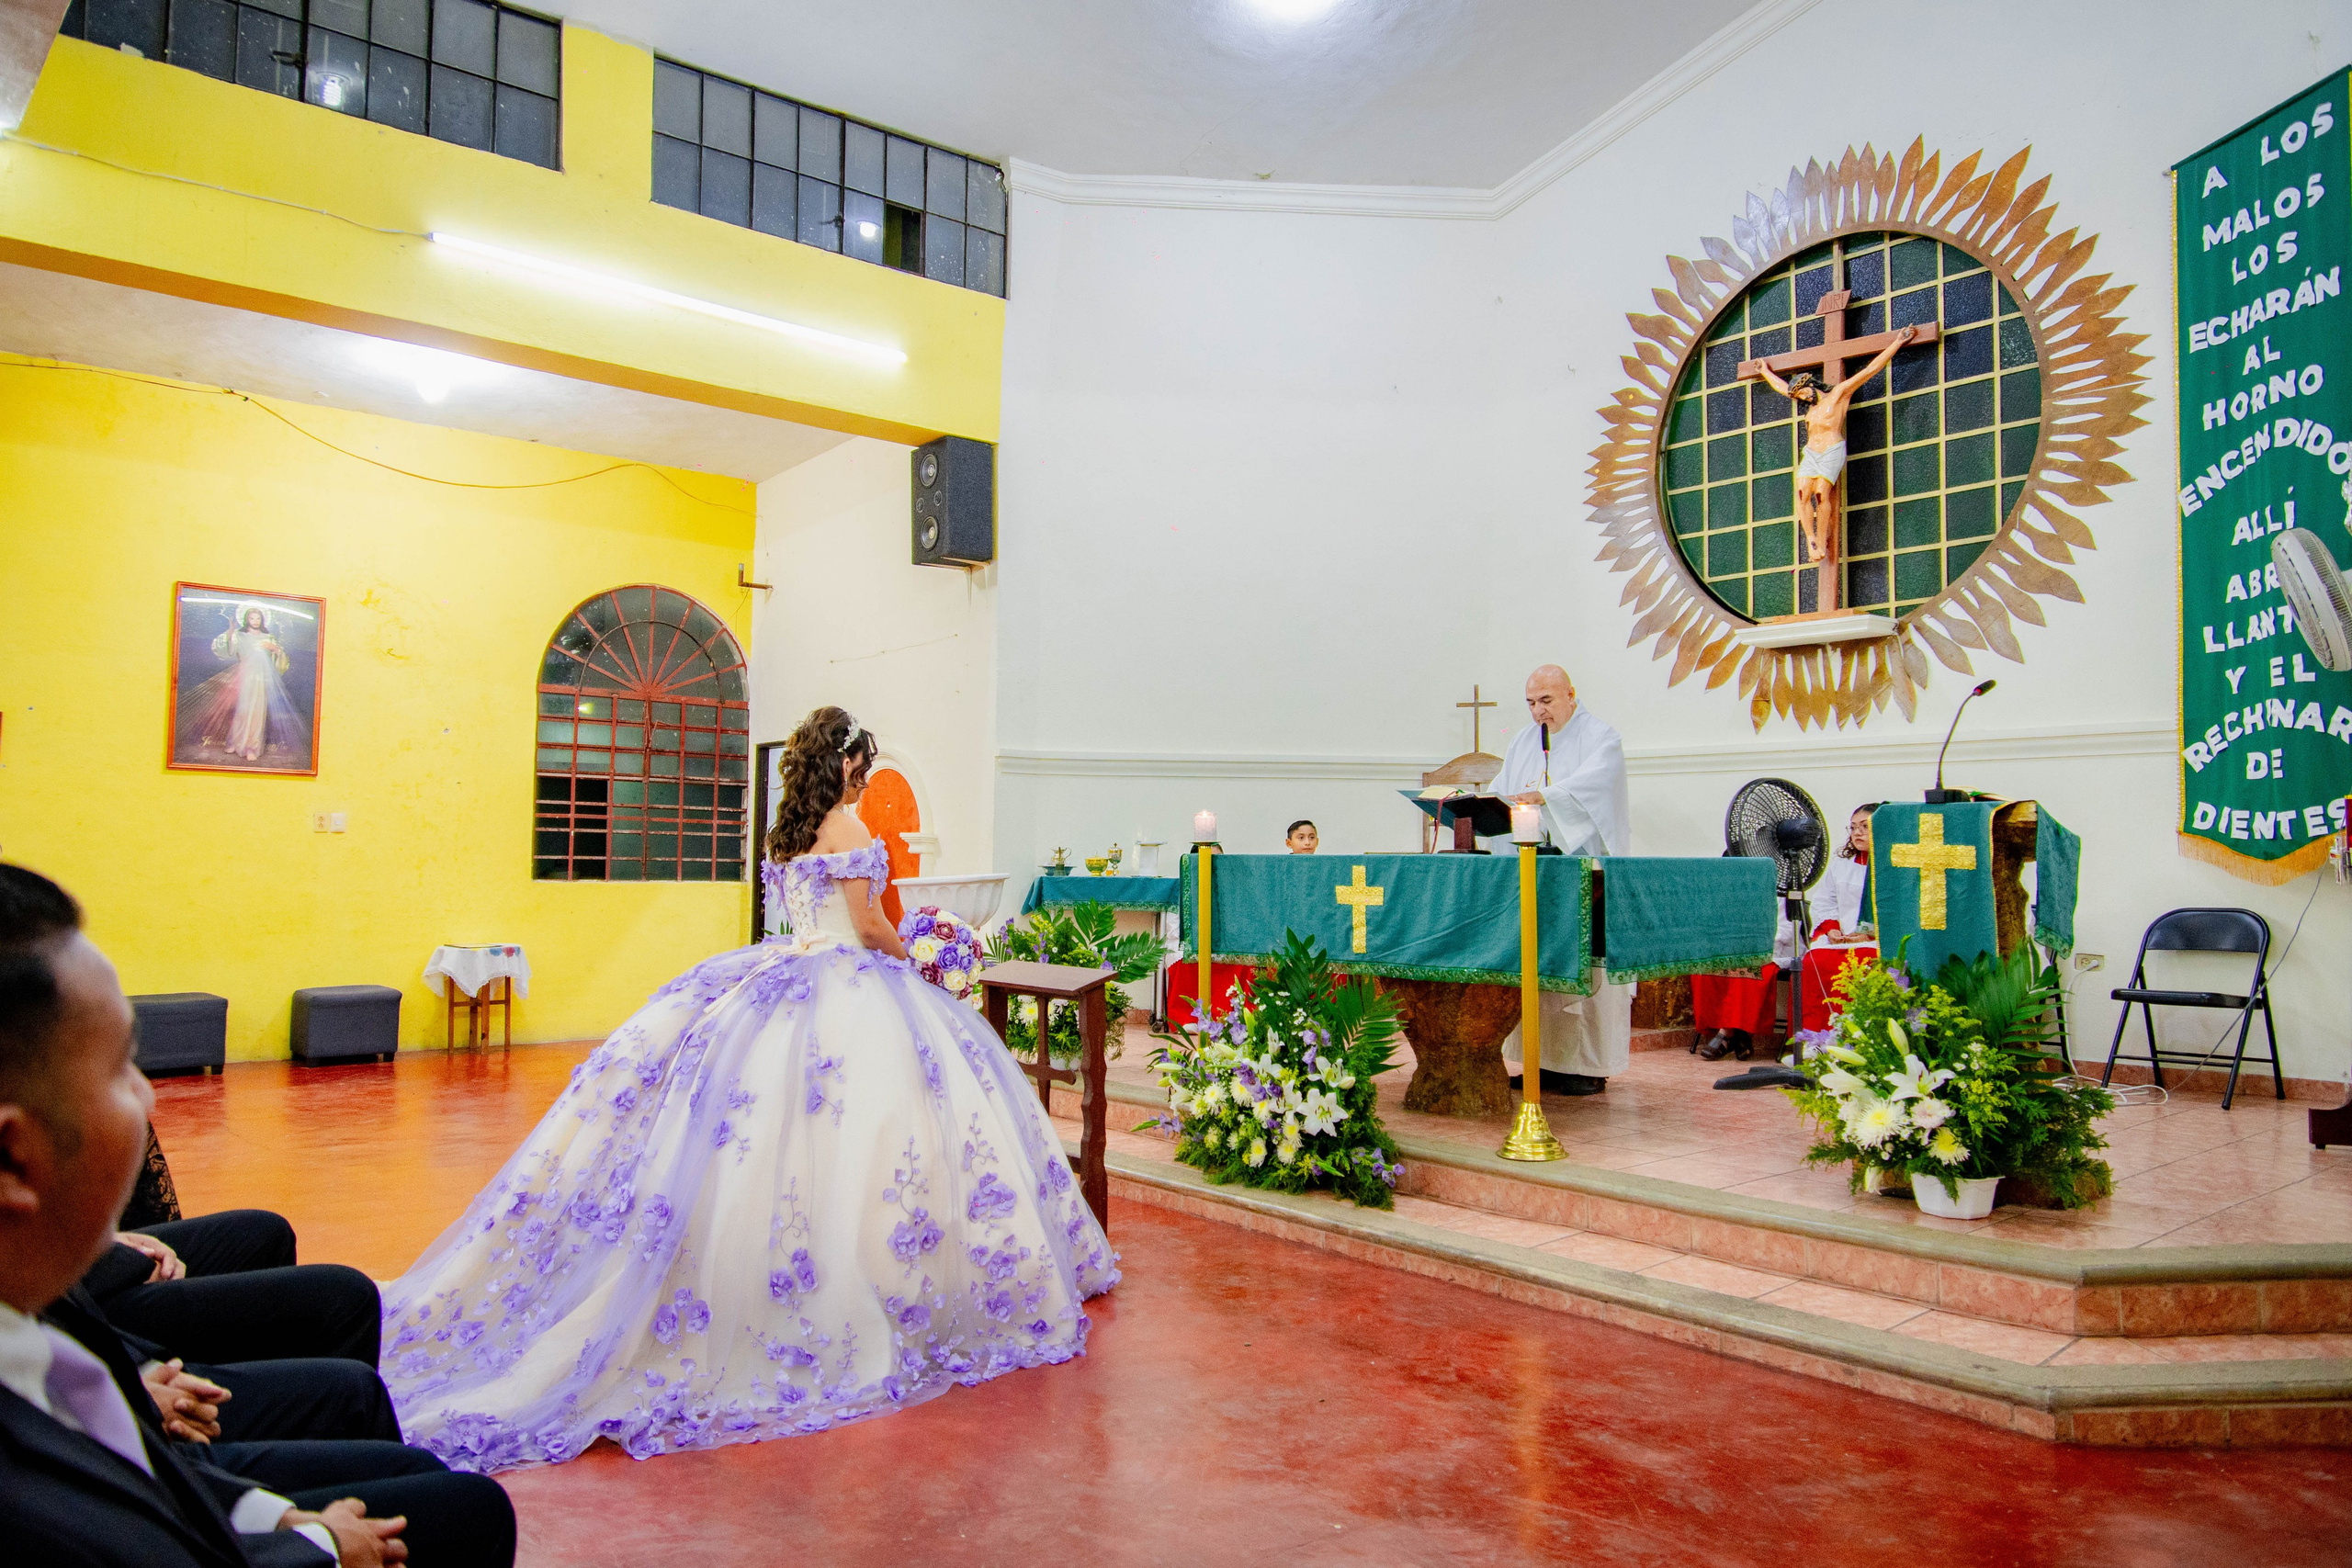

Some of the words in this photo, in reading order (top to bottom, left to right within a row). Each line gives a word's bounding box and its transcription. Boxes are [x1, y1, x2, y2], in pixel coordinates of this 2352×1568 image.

[2202, 165, 2228, 198] A
[2262, 102, 2334, 166] LOS
[2202, 173, 2324, 252] MALOS
[2232, 231, 2298, 286] LOS
[2188, 266, 2340, 354] ECHARÁN
[2243, 336, 2280, 375] AL
[2202, 364, 2324, 431] HORNO
[2177, 417, 2352, 518] ENCENDIDO
[2225, 561, 2281, 604] ABR
[2203, 604, 2293, 654] LLANT
[2225, 666, 2246, 694] Y
[2269, 653, 2316, 687] EL
[2181, 698, 2352, 773] RECHINAR
[2245, 748, 2284, 780] DE
[2192, 797, 2346, 840] DIENTES
